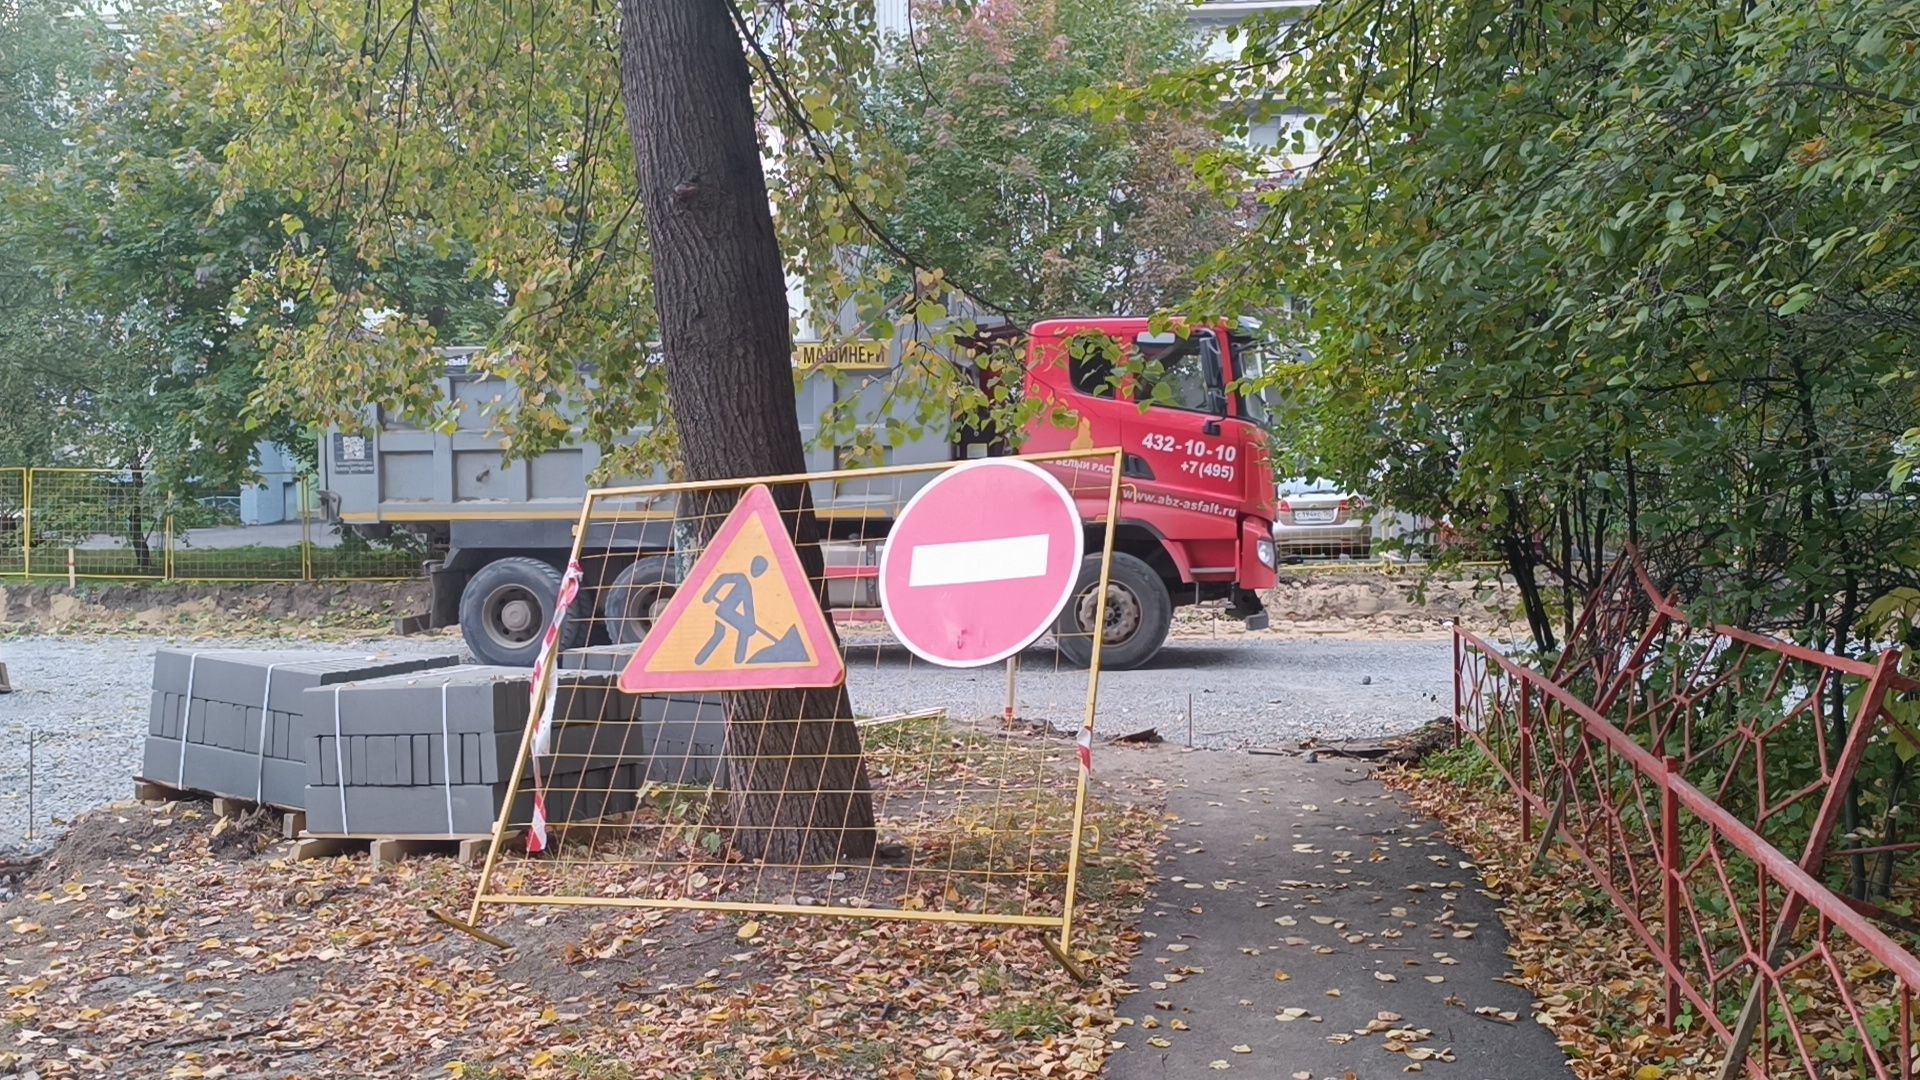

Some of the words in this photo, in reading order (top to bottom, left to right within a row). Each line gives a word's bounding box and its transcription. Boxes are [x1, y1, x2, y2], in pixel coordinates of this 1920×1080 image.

[1142, 432, 1236, 462] 432-10-10
[1181, 461, 1234, 482] +7(495)
[1122, 488, 1237, 518] www.abz-asfalt.ru
